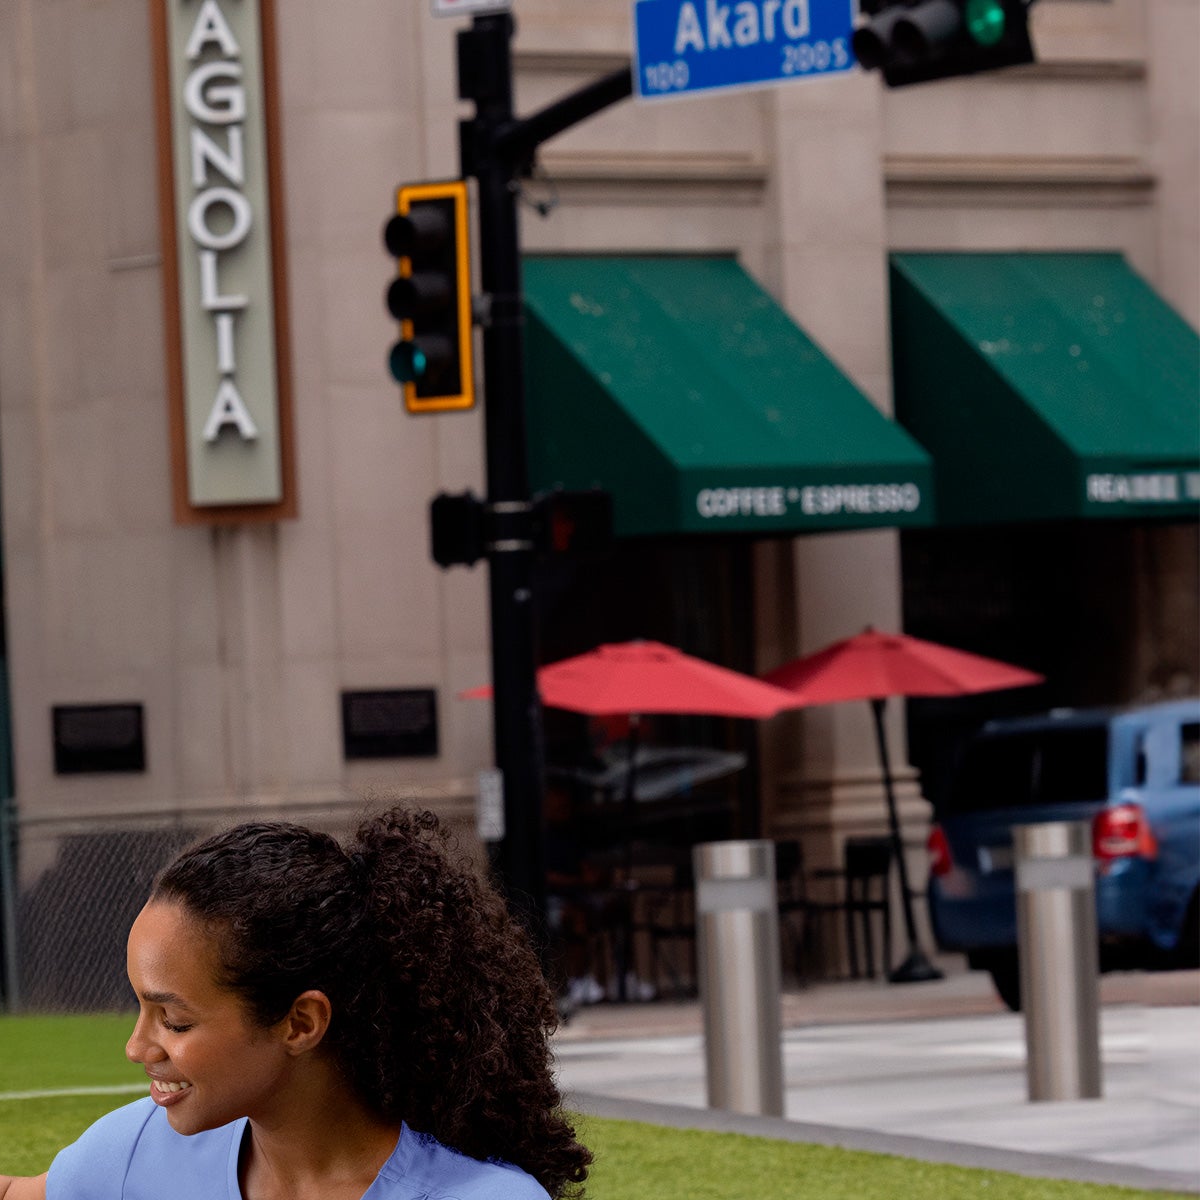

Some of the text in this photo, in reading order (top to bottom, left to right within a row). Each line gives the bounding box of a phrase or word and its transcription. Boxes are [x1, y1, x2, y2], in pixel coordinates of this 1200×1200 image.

[674, 0, 811, 54] Akard
[645, 60, 690, 91] 100
[696, 482, 921, 518] COFFEE ESPRESSO
